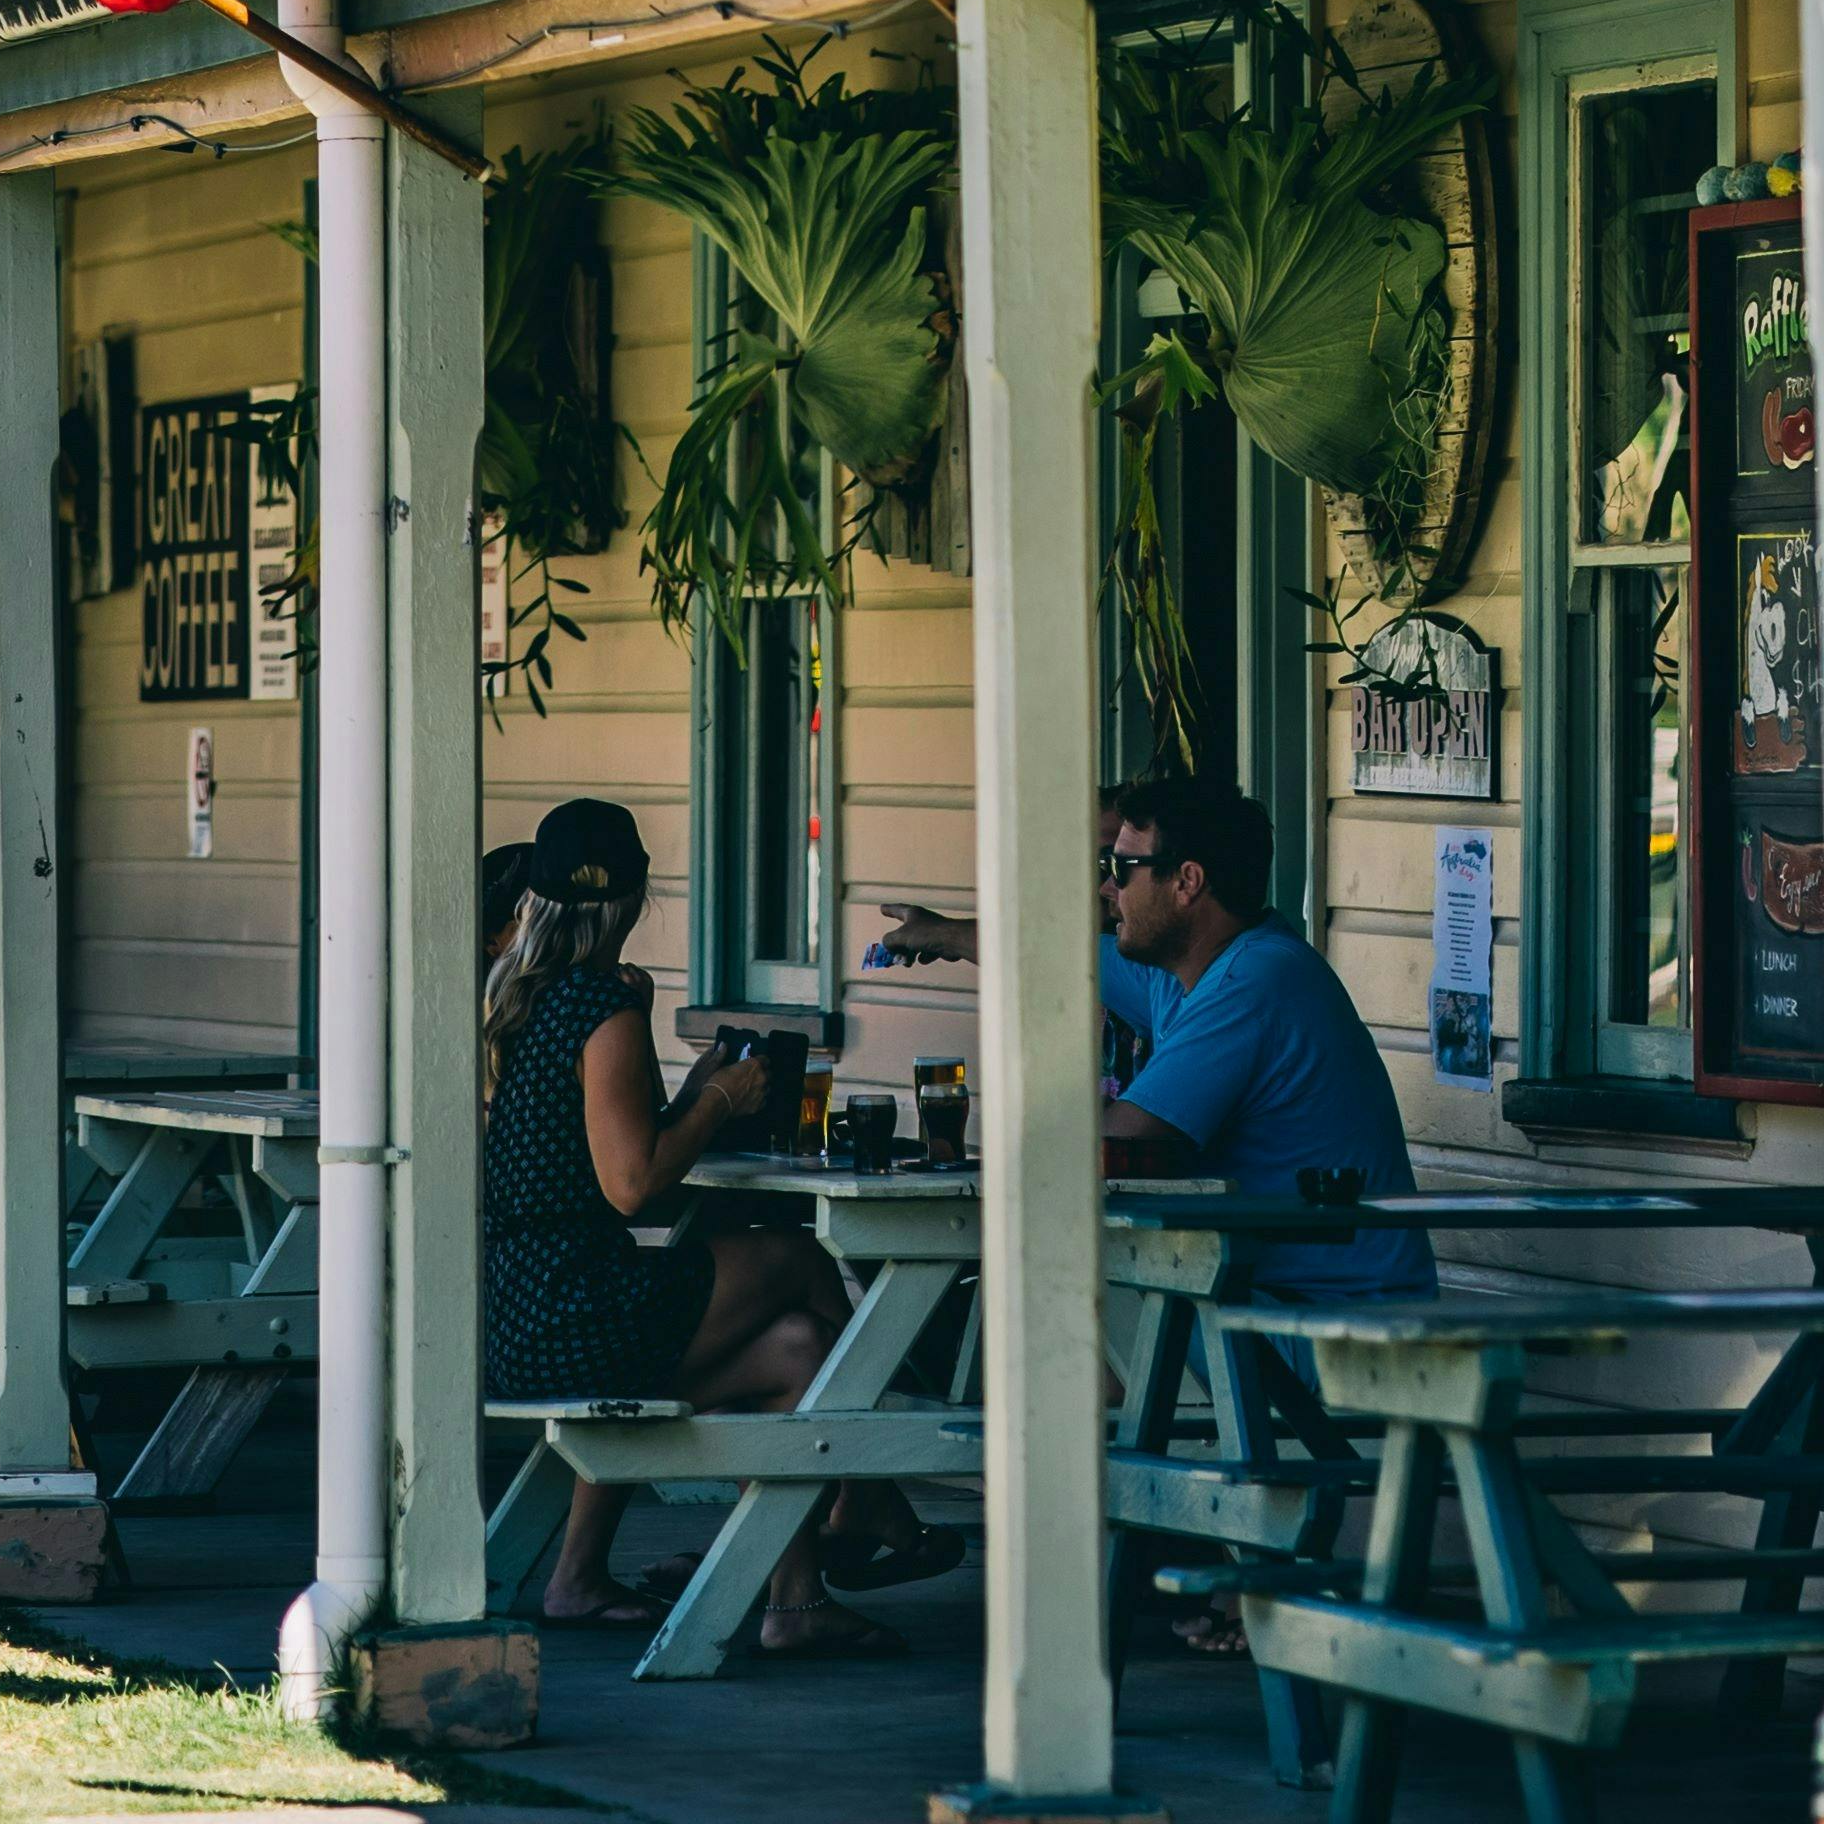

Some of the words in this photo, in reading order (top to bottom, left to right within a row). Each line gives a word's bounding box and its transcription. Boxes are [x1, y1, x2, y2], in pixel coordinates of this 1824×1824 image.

[148, 409, 238, 545] GREAT
[140, 550, 238, 690] COFFEE
[1352, 686, 1403, 753] BAR
[1411, 690, 1487, 756] OPEN
[1762, 949, 1798, 972] LUNCH
[1763, 995, 1799, 1017] DINNER
